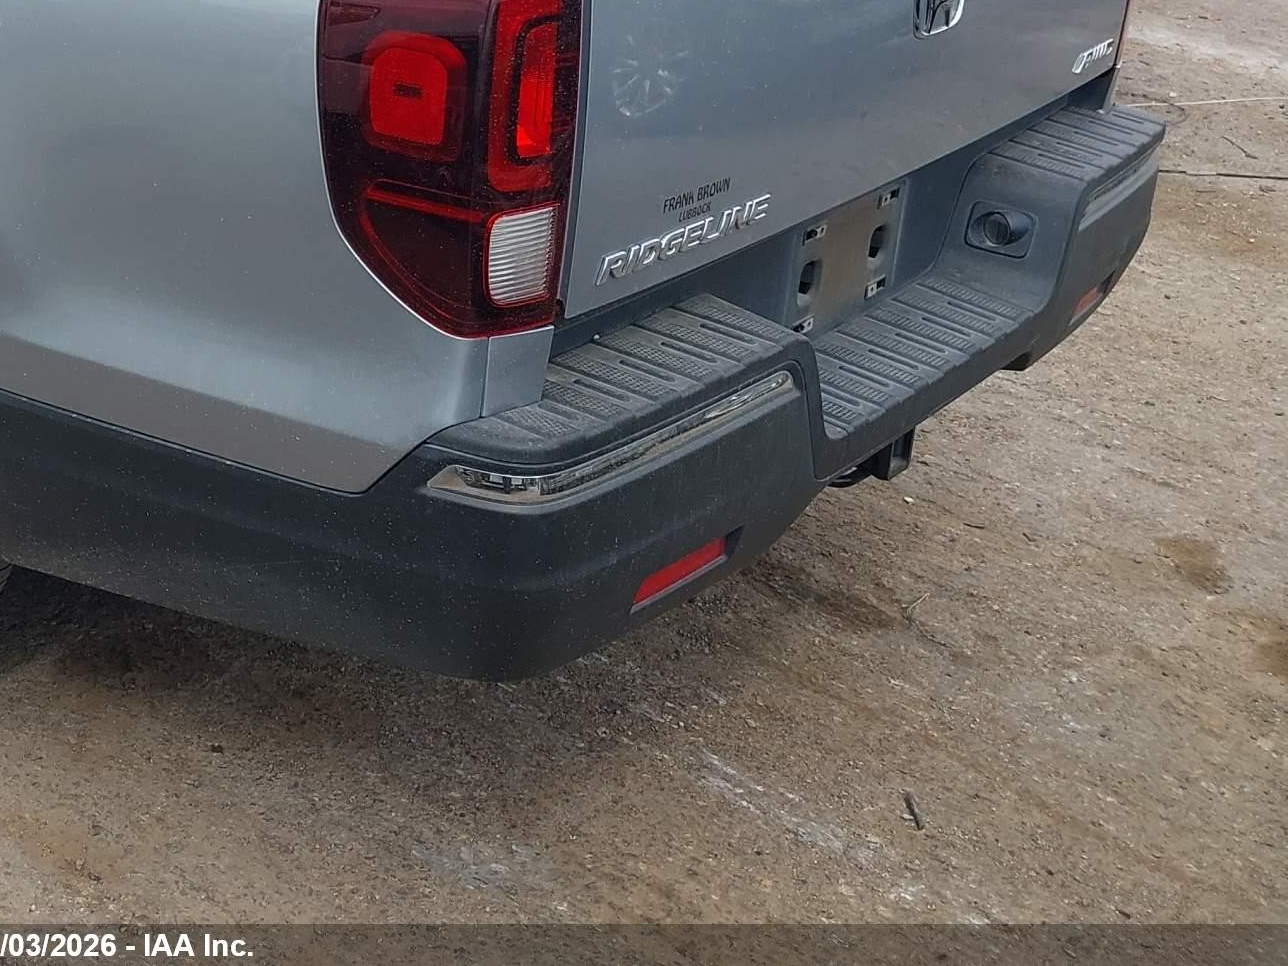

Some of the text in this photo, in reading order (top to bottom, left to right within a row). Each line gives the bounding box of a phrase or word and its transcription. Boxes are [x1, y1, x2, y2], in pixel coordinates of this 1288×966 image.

[663, 177, 731, 214] FRANK BROWN
[678, 201, 712, 222] LUBBOCK
[596, 194, 772, 285] RIDGELINE
